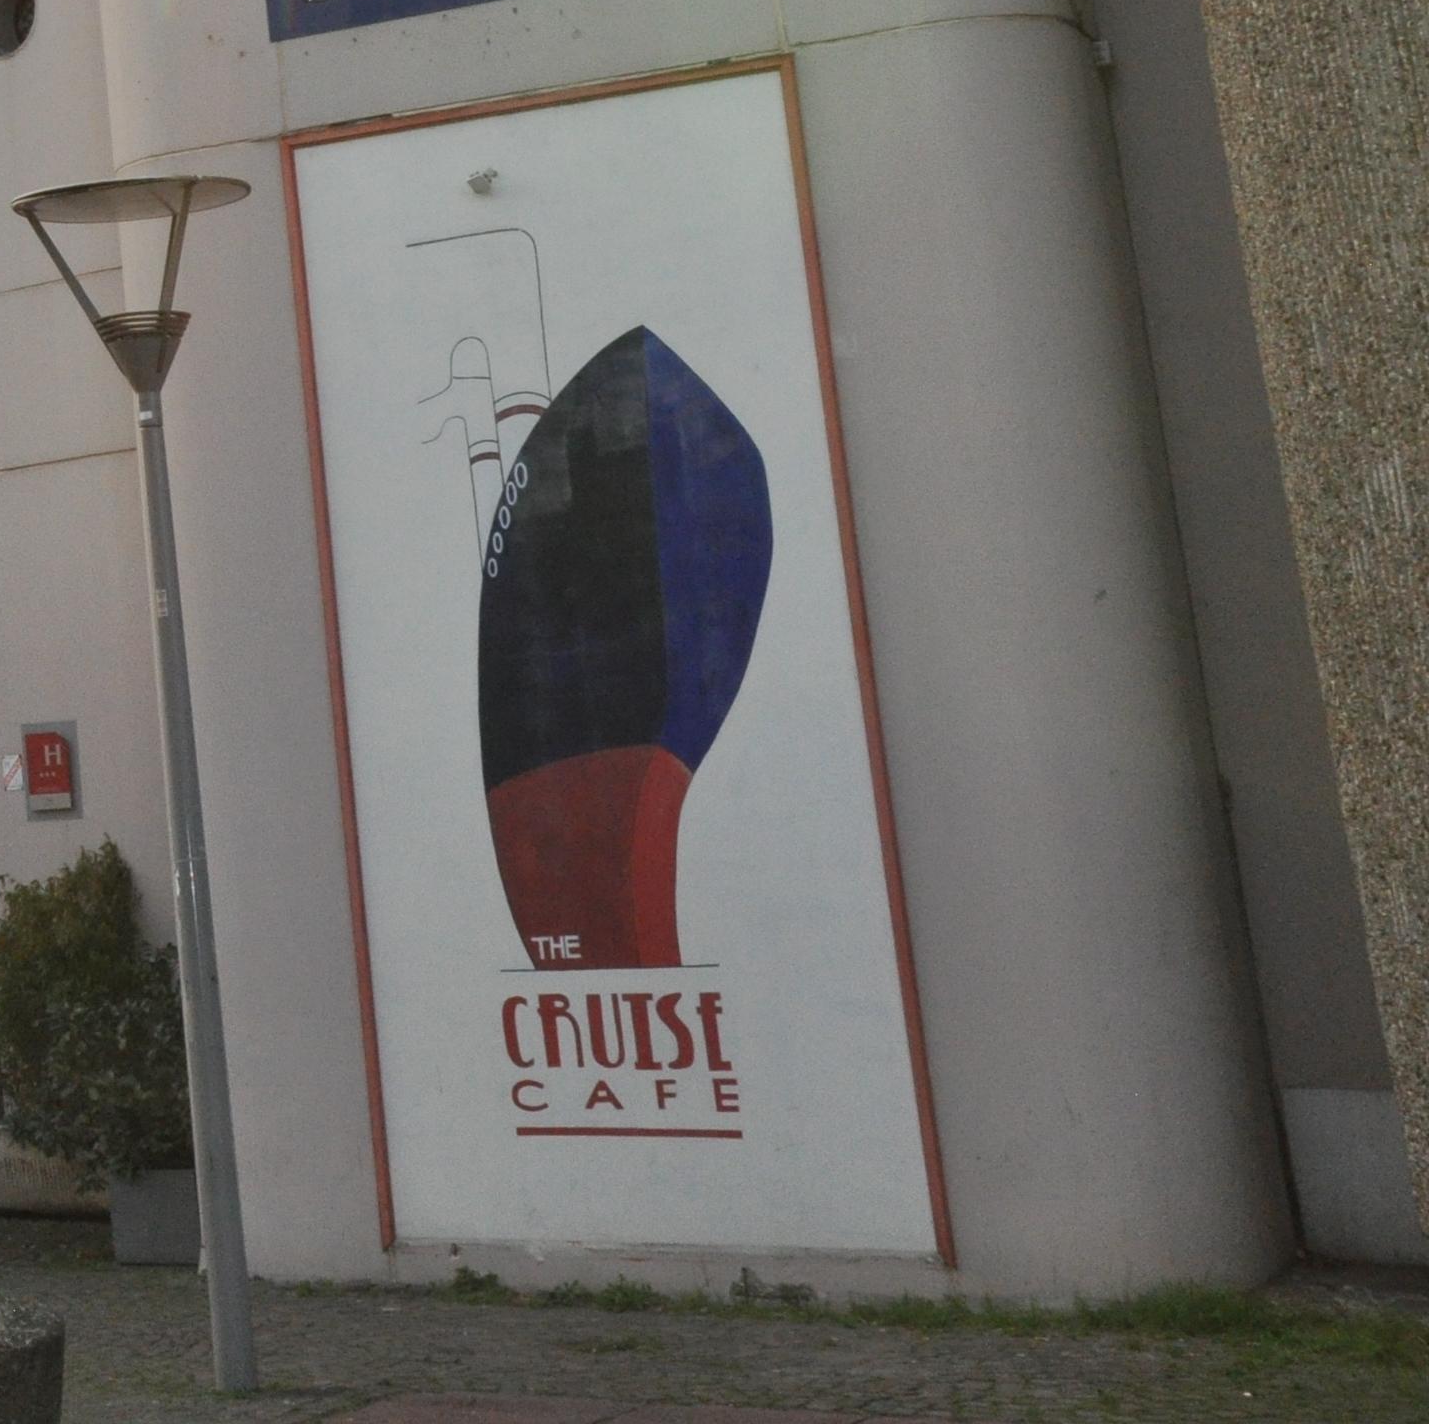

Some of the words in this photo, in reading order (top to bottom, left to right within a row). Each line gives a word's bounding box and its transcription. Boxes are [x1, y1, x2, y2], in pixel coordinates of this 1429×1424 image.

[44, 743, 62, 767] H
[531, 934, 582, 960] THE
[502, 992, 734, 1071] CRUISE
[511, 1078, 740, 1113] CAFE
